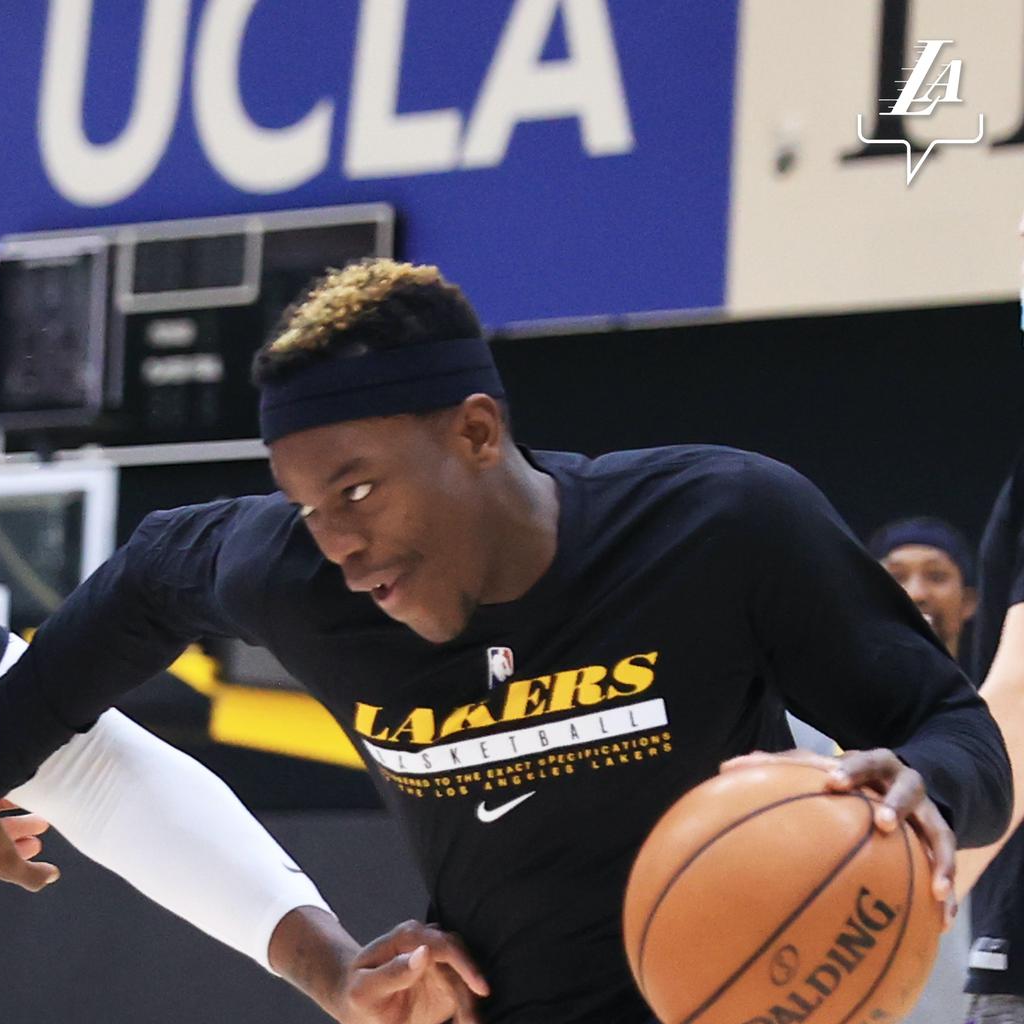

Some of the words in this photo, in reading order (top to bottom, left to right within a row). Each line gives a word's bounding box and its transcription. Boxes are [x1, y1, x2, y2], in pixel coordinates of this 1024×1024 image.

[36, 0, 635, 206] UCLA
[354, 651, 664, 745] LAKERS
[434, 777, 451, 787] TO
[456, 771, 482, 784] THE
[487, 761, 532, 779] EXACT
[538, 731, 672, 767] SPECIFICATIONS
[435, 785, 469, 798] LOS
[484, 764, 575, 791] ANGELES
[591, 742, 673, 769] LAKERS
